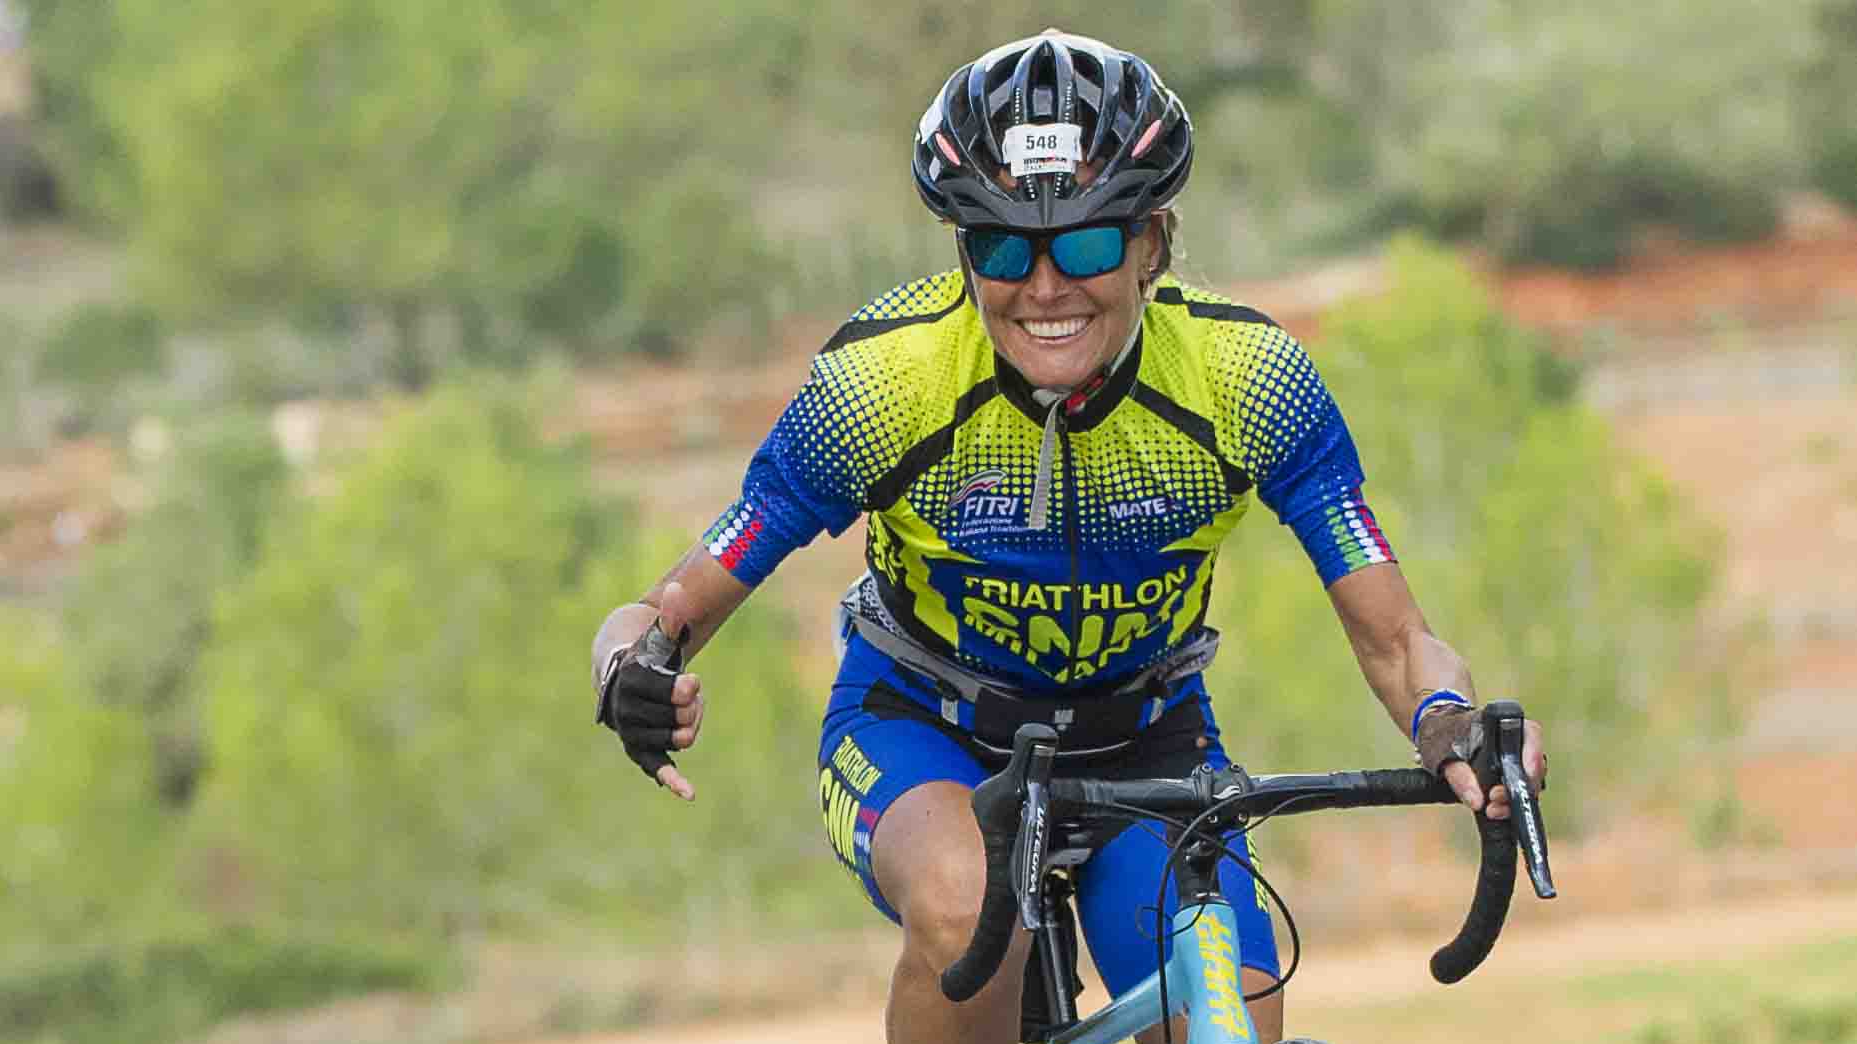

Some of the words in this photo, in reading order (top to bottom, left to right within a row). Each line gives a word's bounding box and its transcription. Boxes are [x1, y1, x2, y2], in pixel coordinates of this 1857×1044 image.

[1025, 134, 1057, 151] 548
[964, 496, 1019, 519] FITRI
[1108, 497, 1167, 519] MATE
[962, 564, 1187, 611] TRIATHLON
